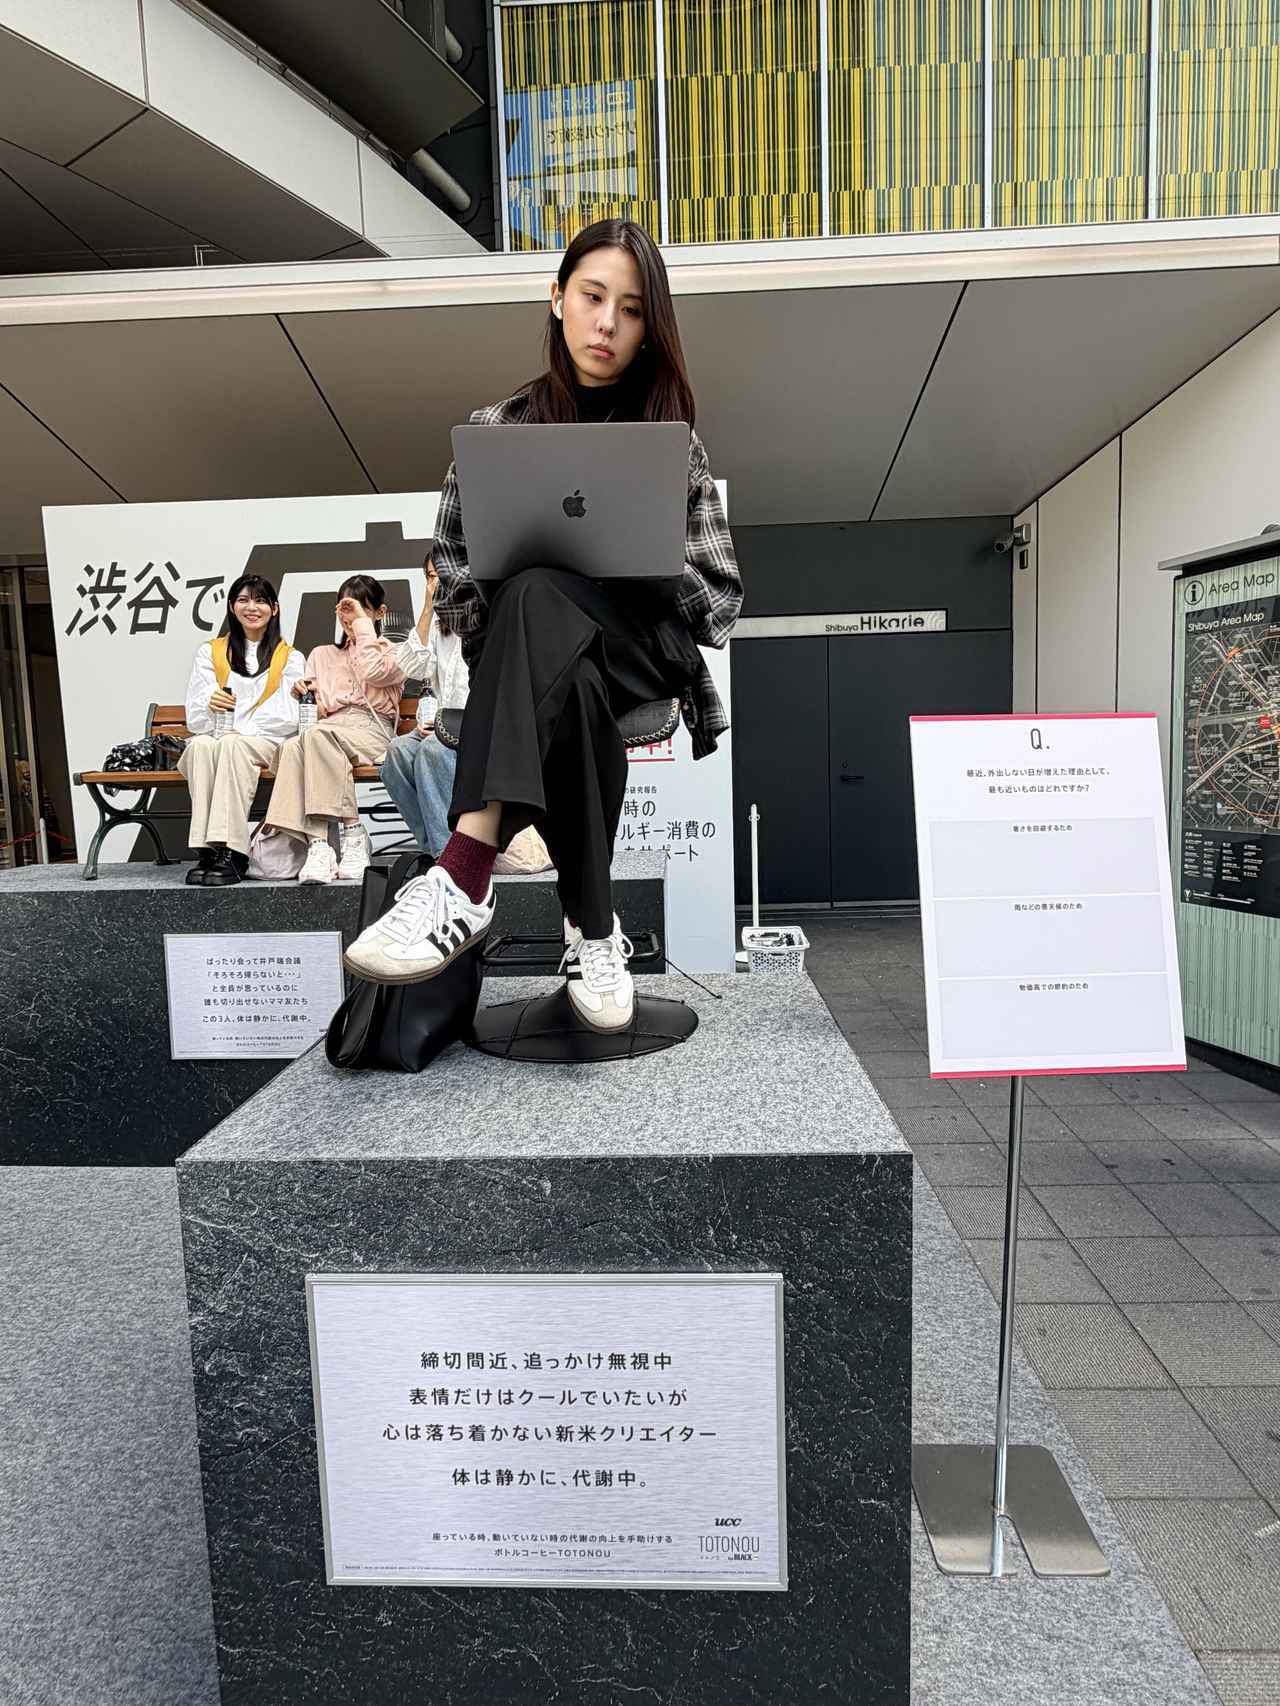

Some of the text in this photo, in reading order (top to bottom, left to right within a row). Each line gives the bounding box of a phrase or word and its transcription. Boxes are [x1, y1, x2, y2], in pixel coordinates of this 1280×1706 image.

[1208, 572, 1275, 595] Area Map
[65, 561, 225, 636] 渋谷で
[825, 615, 925, 633] Shibuya Hikarie
[1187, 611, 1265, 633] Shibuya Area Map
[1030, 728, 1050, 750] Q.
[614, 820, 717, 841] ルギー消費の
[212, 984, 299, 993] と全員が思っているのに
[203, 998, 309, 1006] 誰も切り出せないママ友たち
[420, 1351, 673, 1371] 締切間近、追っかけ無視中
[408, 1387, 688, 1408] 表情だけはクールでいたいが
[382, 1423, 718, 1443] 心は落ち着かない新米クリエイター
[451, 1468, 649, 1489] 体は静かに、代謝中。
[431, 1531, 674, 1545] 座っている時、動いていない時の代謝の向上を手助けする
[697, 1535, 760, 1553] TOTONOU
[493, 1548, 613, 1559] ボトルコーヒーTOTONOU
